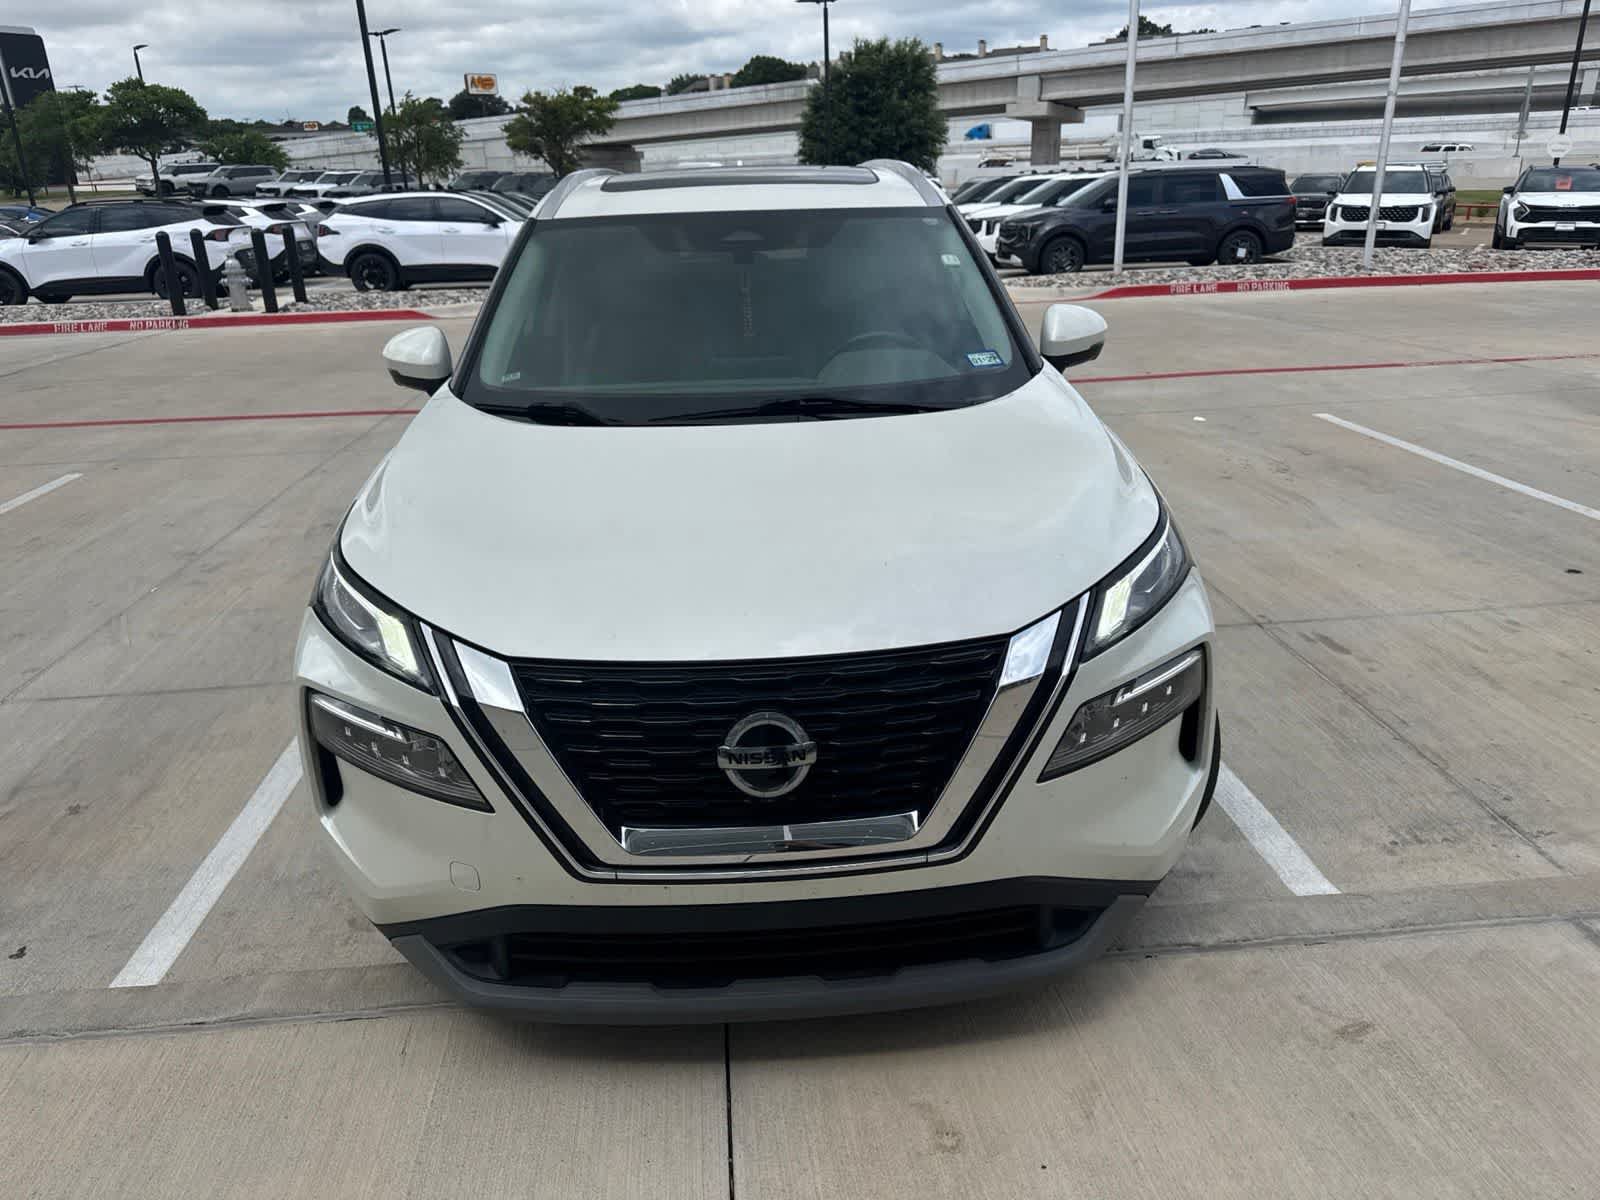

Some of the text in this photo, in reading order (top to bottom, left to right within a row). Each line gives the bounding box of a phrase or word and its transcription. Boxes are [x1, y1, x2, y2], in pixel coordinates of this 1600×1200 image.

[1170, 280, 1289, 294] FIRE LANE NO PARKING
[54, 322, 78, 333] FIRE
[129, 320, 143, 330] NO
[728, 749, 806, 766] NISSAN
